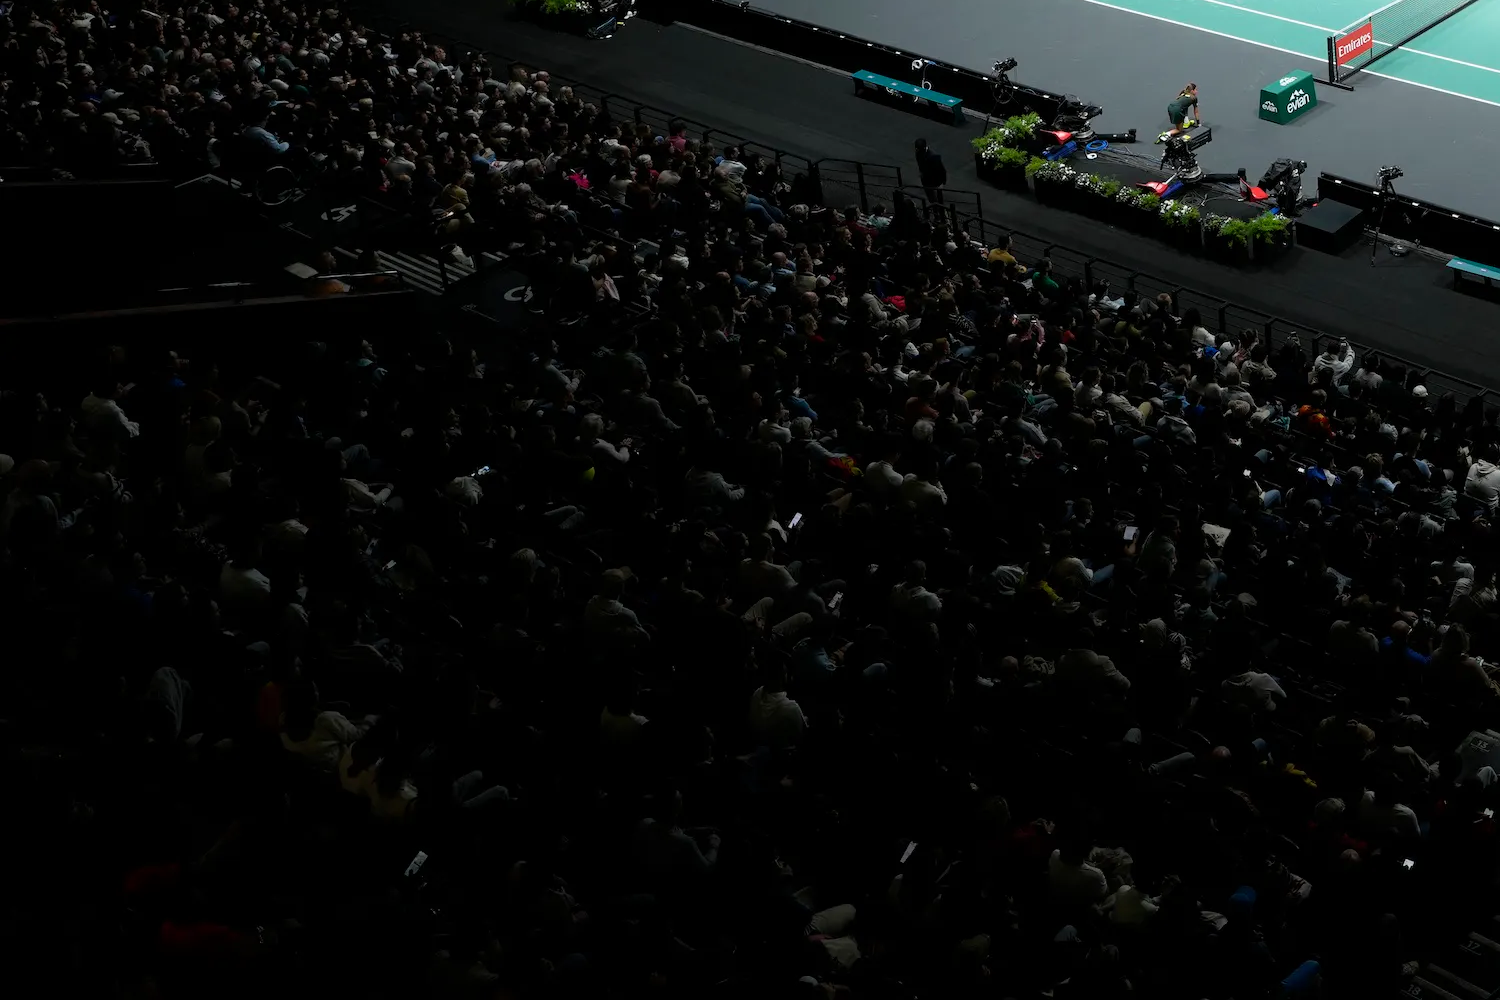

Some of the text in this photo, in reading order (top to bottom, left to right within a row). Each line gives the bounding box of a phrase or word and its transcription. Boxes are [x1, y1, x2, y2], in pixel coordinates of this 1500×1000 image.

[1338, 31, 1372, 58] Emirates
[1262, 103, 1278, 113] evian
[1286, 93, 1310, 114] evian
